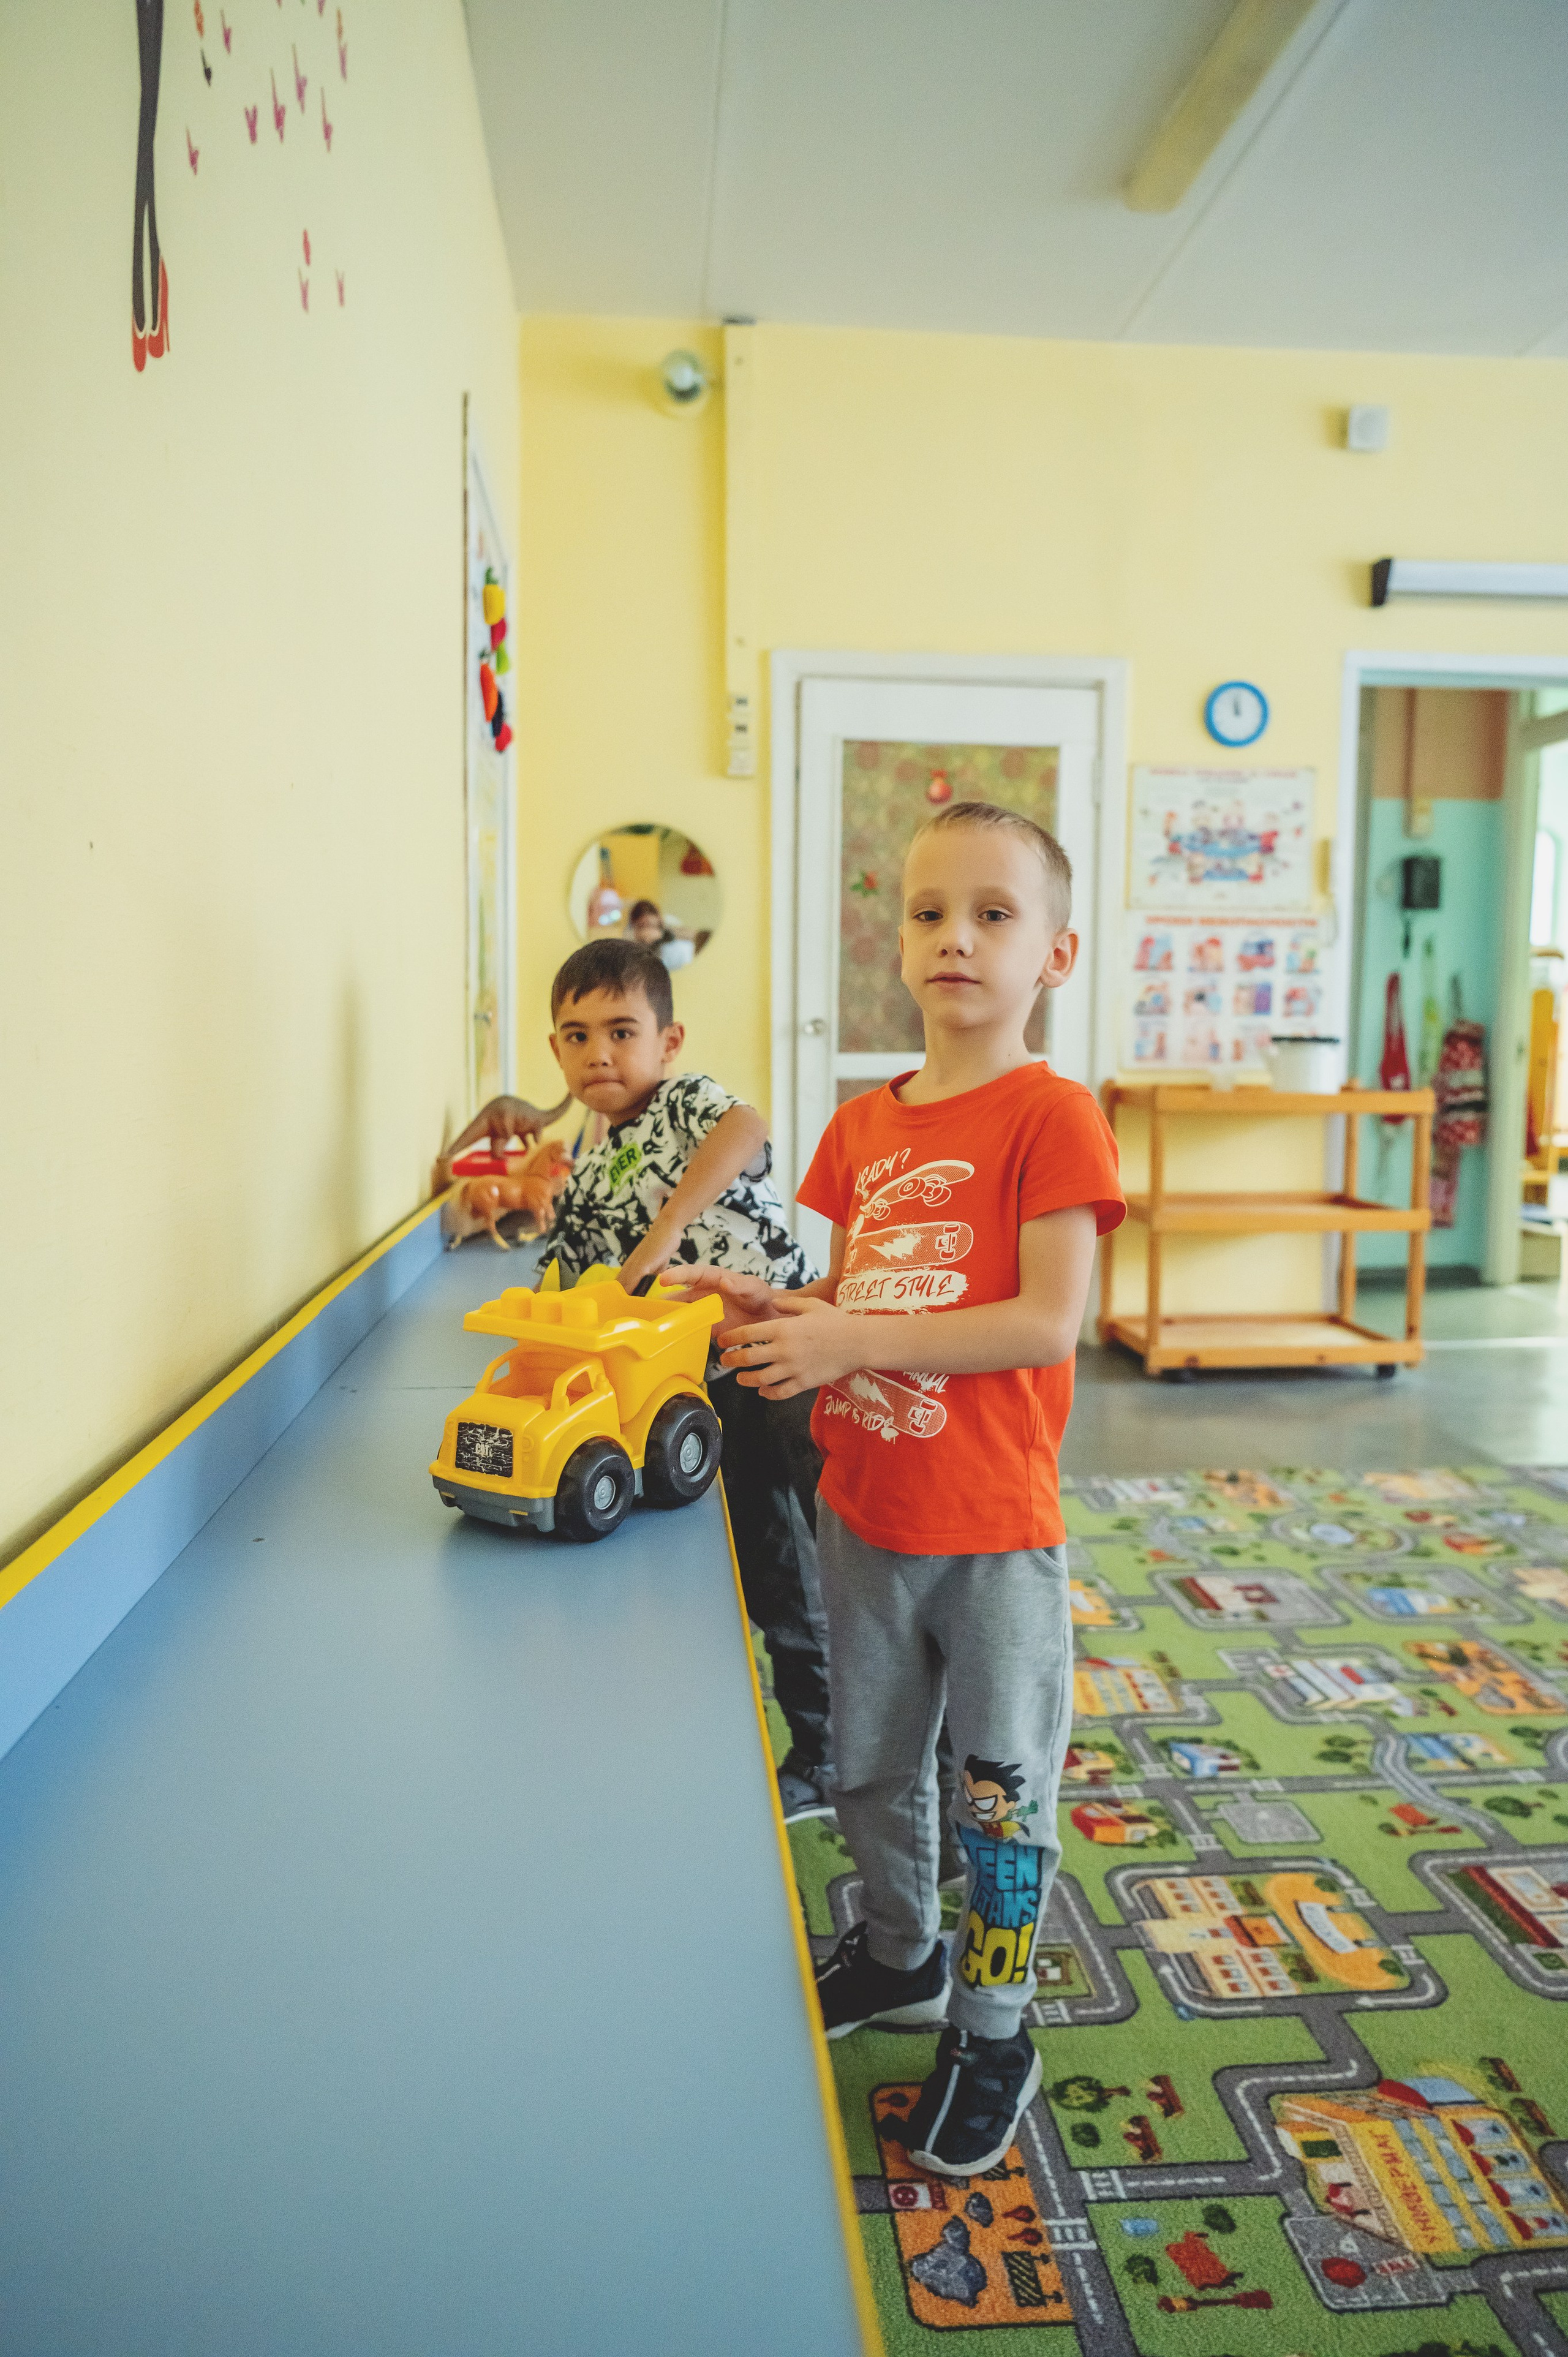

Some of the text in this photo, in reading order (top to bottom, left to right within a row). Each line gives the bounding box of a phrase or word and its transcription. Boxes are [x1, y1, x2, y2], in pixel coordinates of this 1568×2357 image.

[837, 1273, 954, 1306] STREET STYLE
[824, 1395, 851, 1418] JUMP
[475, 1443, 489, 1456] CAT
[962, 1909, 1034, 1986] GO!
